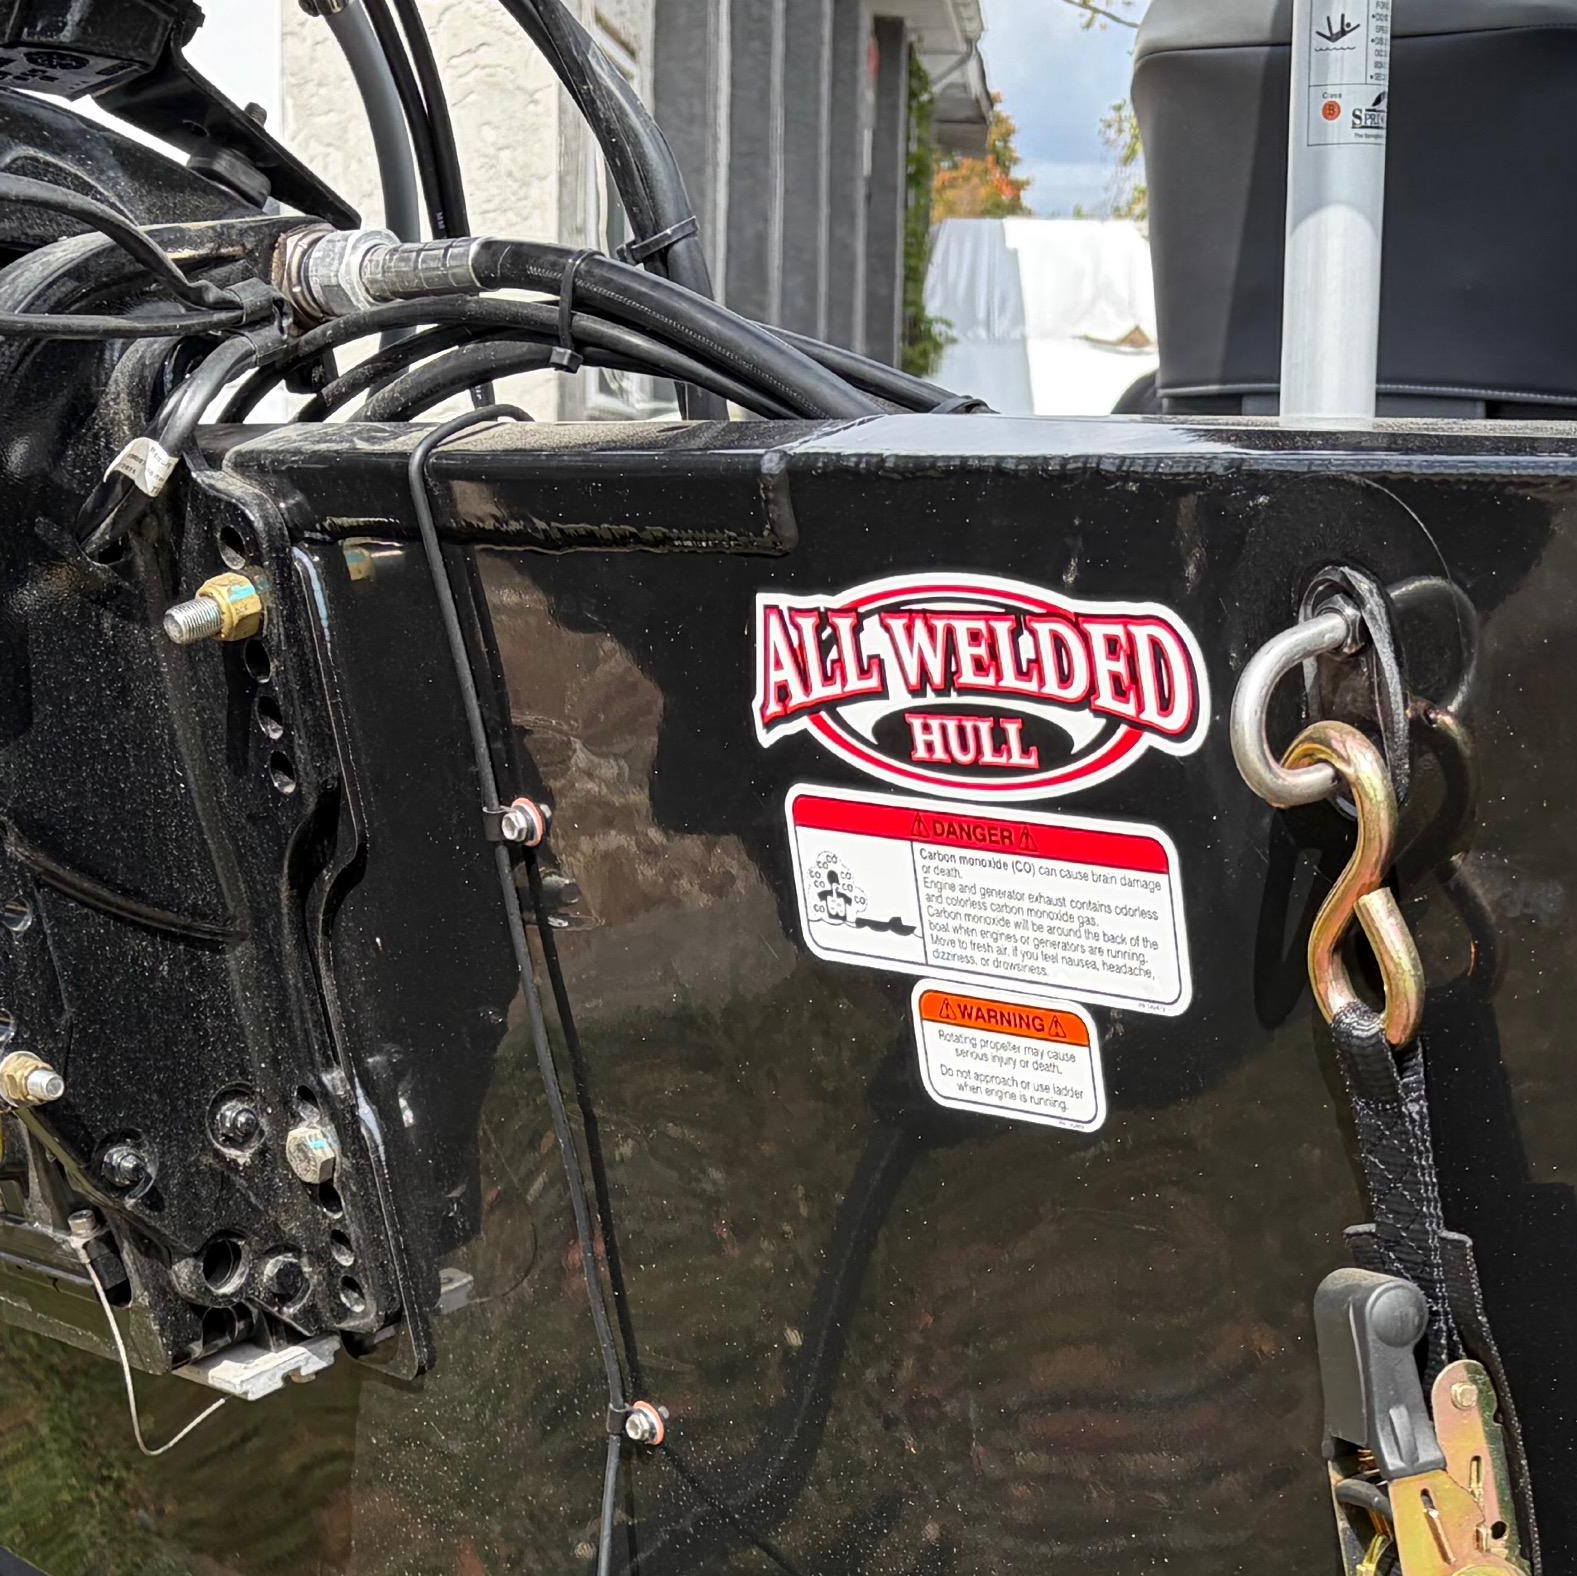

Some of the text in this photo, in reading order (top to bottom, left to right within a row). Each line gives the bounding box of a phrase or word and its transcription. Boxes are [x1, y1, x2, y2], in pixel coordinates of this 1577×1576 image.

[1352, 108, 1384, 126] SPRI
[761, 605, 1193, 738] ALL WELDED
[904, 713, 1039, 769] HULL
[932, 822, 1014, 847] DANGER
[920, 848, 1161, 893] Carbon monoxide (CO) can cause brain damage
[922, 864, 963, 879] or death.
[924, 877, 1158, 921] Engine and generator exhaust contains odorless
[925, 892, 1099, 927] and colorless carbon monoxide gas.
[927, 905, 1158, 950] Carbon monoxide will be around the back of the
[929, 920, 1148, 964] boat when engines or generators are running.
[958, 938, 967, 950] to
[970, 939, 994, 953] fresh
[1020, 950, 1038, 962] you
[1062, 955, 1099, 971] nausea,
[1102, 960, 1154, 980] headache,
[981, 957, 990, 967] or
[958, 1004, 1045, 1033] WARNING
[938, 1030, 1076, 1063] Rotating propeller may cause
[956, 1048, 989, 1062] serious
[991, 1053, 1016, 1069] injury
[1020, 1060, 1029, 1068] or
[940, 1064, 1083, 1099] Do not approach or use ladder
[957, 1082, 981, 1096] when
[985, 1088, 1017, 1101] engine
[1019, 1091, 1027, 1102] is
